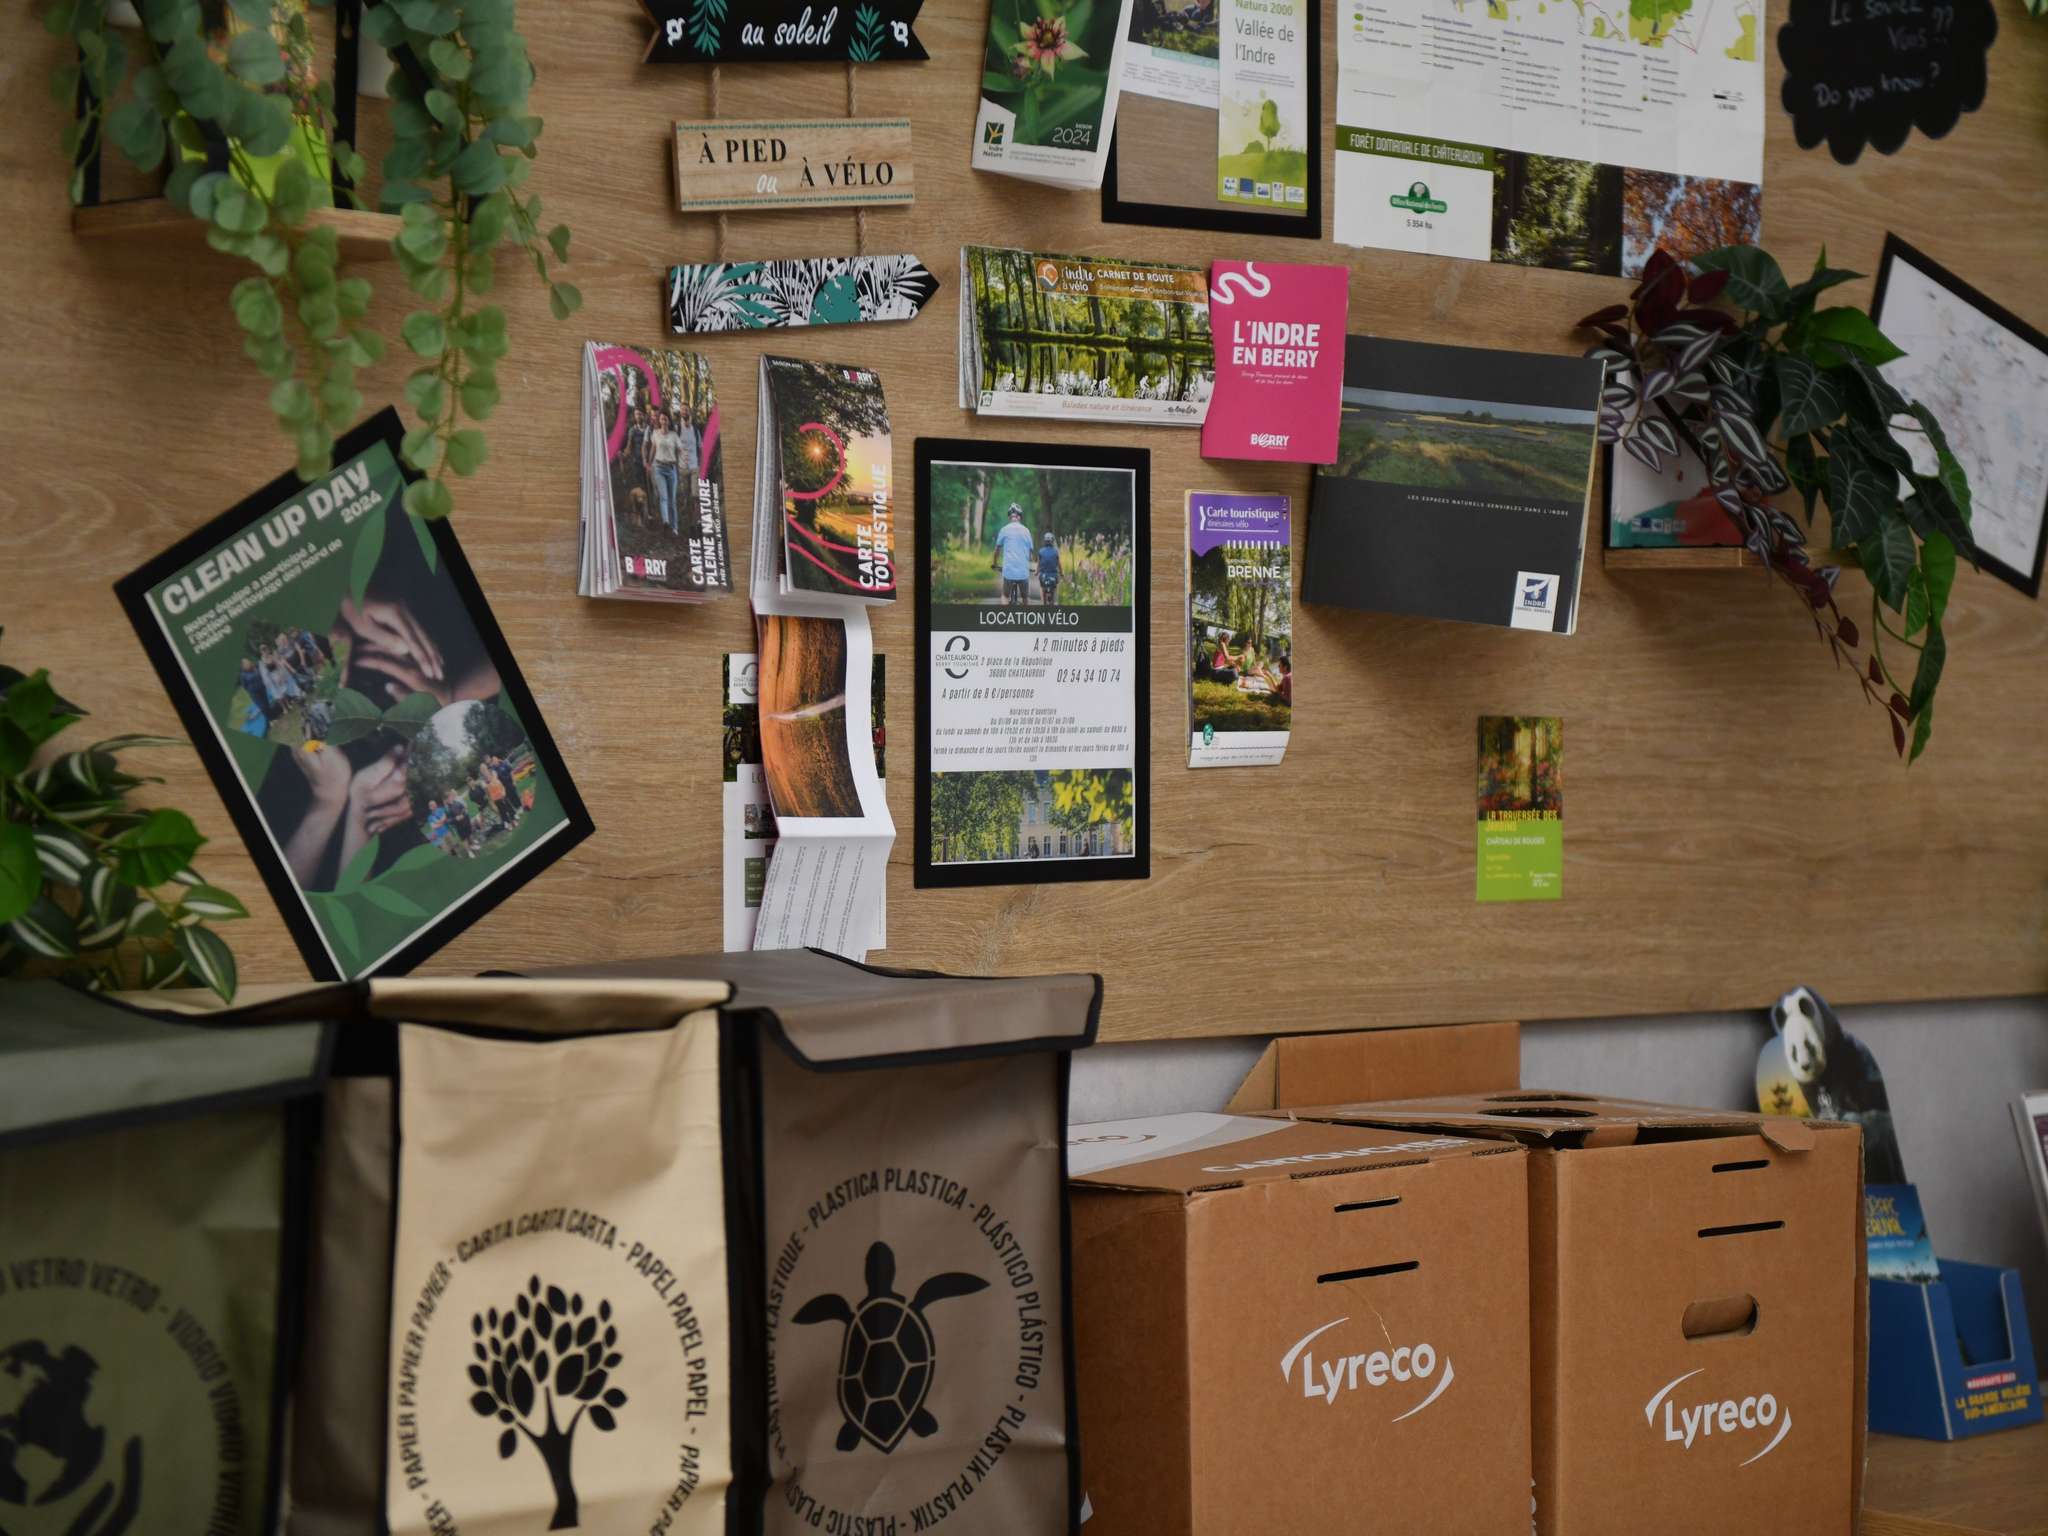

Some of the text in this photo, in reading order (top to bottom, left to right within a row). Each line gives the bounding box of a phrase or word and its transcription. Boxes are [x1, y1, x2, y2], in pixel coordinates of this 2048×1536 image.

[1270, 2, 1293, 16] 2000
[741, 5, 838, 45] au soleil
[1235, 17, 1294, 42] Vallée de
[1235, 42, 1275, 65] l'Indre
[1814, 82, 1840, 107] Do
[699, 133, 787, 163] À PIED
[1052, 127, 1091, 145] 2024
[1349, 133, 1374, 149] FORÊT
[1375, 137, 1418, 156] DOMANIALE
[1421, 143, 1431, 157] DE
[756, 156, 894, 194] ou À VÉLO
[1070, 280, 1089, 292] vélo
[1096, 269, 1131, 281] CARNET
[1133, 271, 1145, 281] DE
[1146, 273, 1175, 283] ROUTE
[1233, 320, 1320, 347] L'INDRE
[1232, 346, 1319, 368] EN BERRY
[340, 490, 383, 524] 2024
[1207, 506, 1280, 522] Carte touristique
[162, 460, 371, 615] CLEAN UP DAY
[689, 478, 719, 586] CARTE PLEINE NATURE
[857, 463, 890, 589] CARTE TOURISTIQUE
[1227, 565, 1281, 578] BRENNE
[979, 609, 1079, 625] LOCATION VÉLO
[935, 653, 979, 661] CHÂTEAUROUX
[1042, 638, 1048, 651] 2
[1051, 637, 1088, 652] minutes
[1091, 638, 1096, 652] à
[1100, 638, 1125, 653] pieds
[1056, 668, 1121, 683] 02 54 34 10 74
[949, 688, 971, 700] partir
[972, 688, 983, 699] de
[807, 1168, 969, 1230] PLASTICA PLASTICA
[456, 1220, 515, 1263] CARTA
[566, 1209, 618, 1250] CARTA
[972, 1203, 1048, 1389] PLÁSTICO PLÁSTICO
[626, 1241, 709, 1422] PAPEL PAPEL PAPEL
[398, 1260, 452, 1491] PAPIER PAPIER PAPIER
[1303, 1342, 1437, 1406] Lyreco
[1664, 1392, 1777, 1450] Lyreco
[672, 1443, 701, 1513] PAPIER
[910, 1405, 1027, 1532] PLASTIK PLASTIK
